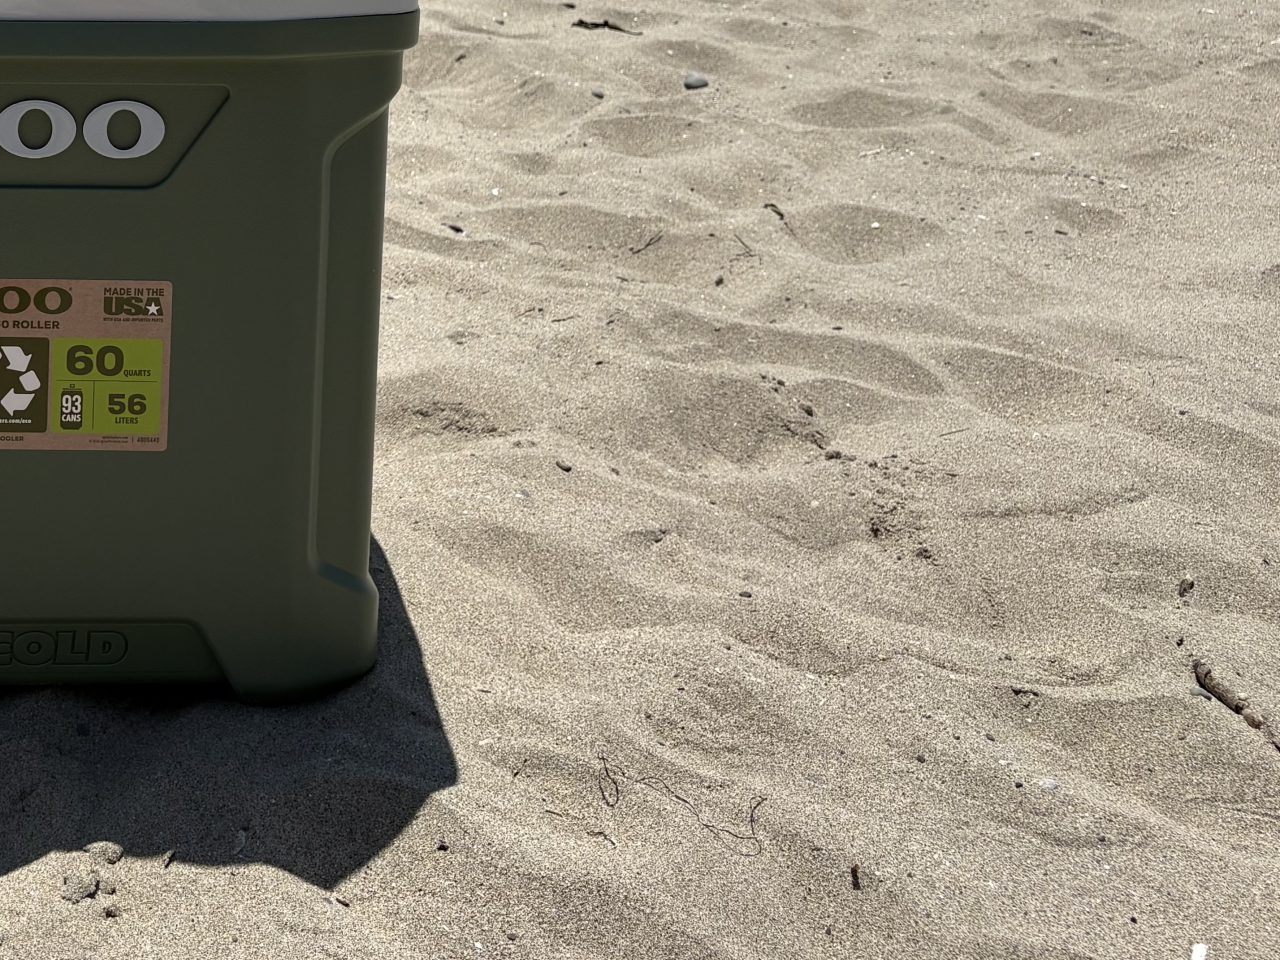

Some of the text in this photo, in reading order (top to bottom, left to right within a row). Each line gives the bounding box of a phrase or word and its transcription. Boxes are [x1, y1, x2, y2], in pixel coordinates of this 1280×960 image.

[104, 287, 165, 296] MADE IN THE
[104, 297, 164, 316] USA
[12, 321, 60, 330] ROLLER
[66, 345, 124, 376] 60
[62, 394, 82, 414] 93
[108, 393, 147, 415] 56
[61, 414, 82, 422] CANS
